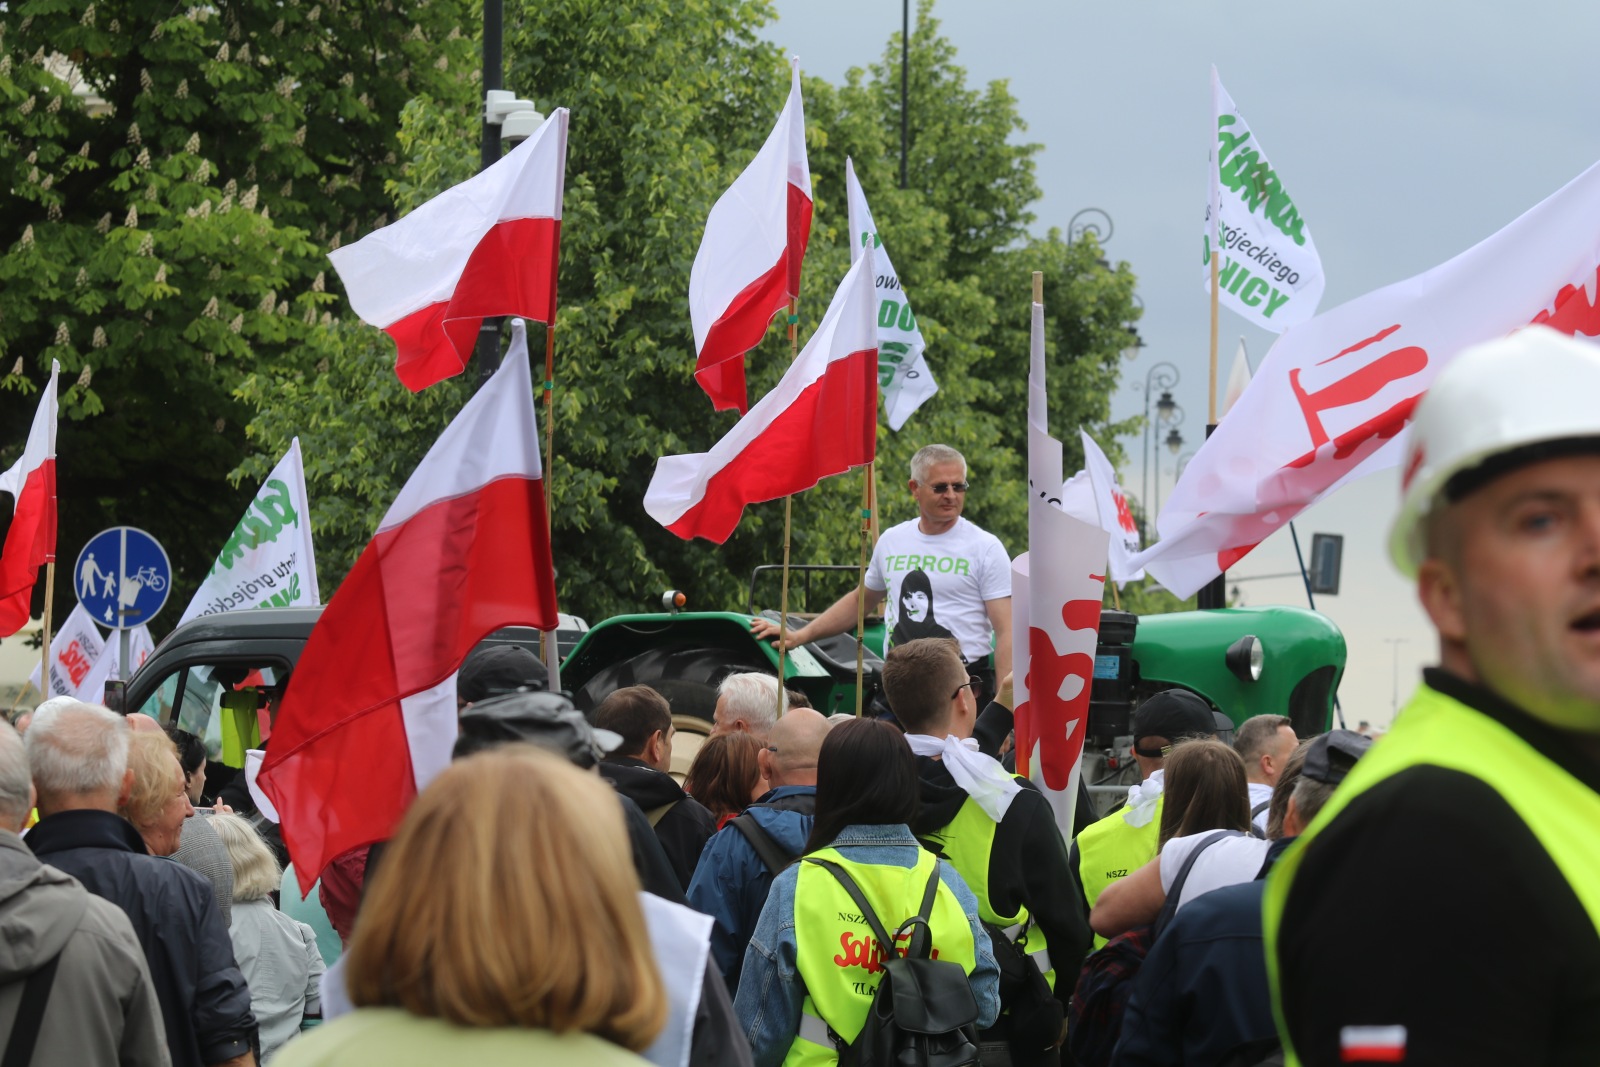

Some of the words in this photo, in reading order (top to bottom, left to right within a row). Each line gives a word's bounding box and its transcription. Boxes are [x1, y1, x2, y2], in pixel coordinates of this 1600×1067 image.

[1224, 224, 1300, 285] rójeckiego
[885, 555, 970, 577] TERROR
[1106, 869, 1128, 879] NSZZ
